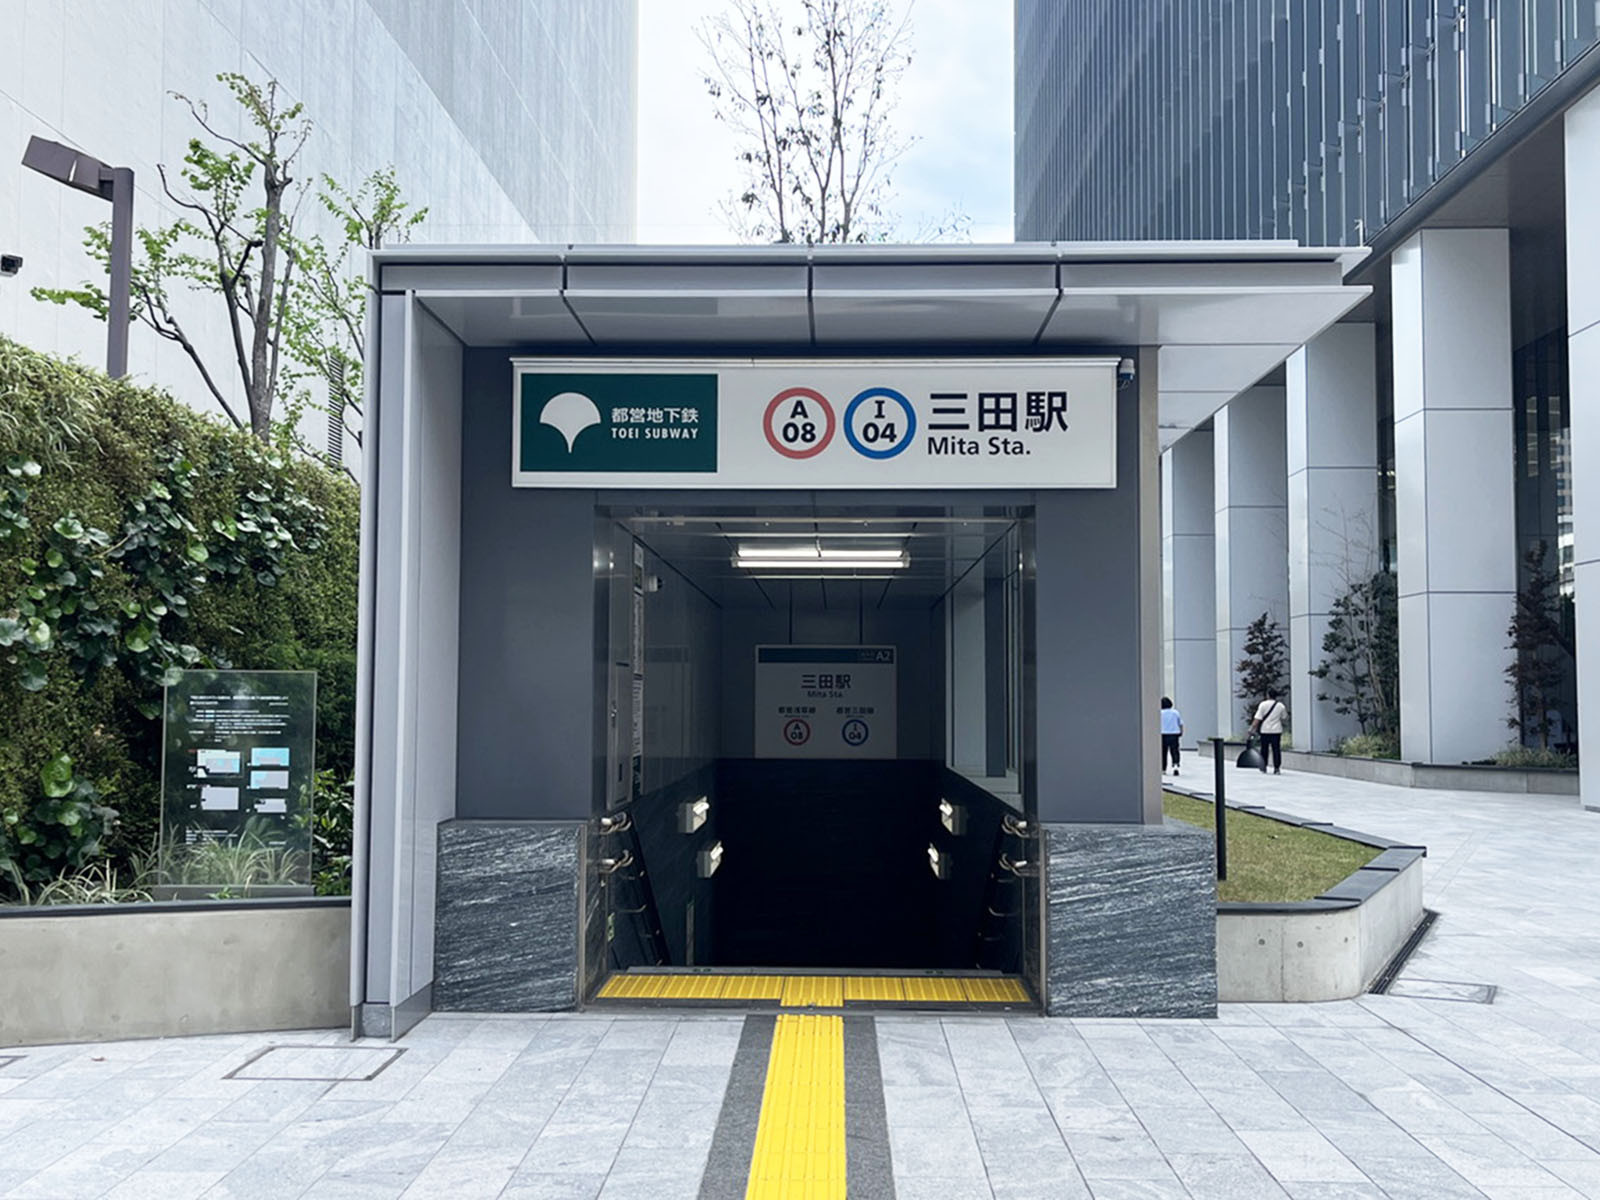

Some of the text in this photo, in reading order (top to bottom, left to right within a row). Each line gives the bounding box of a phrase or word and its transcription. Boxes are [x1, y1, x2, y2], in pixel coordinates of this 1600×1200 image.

[611, 407, 699, 424] 都営地下鉄
[790, 400, 809, 420] A
[874, 400, 886, 419] I
[928, 391, 1068, 432] 三田駅
[611, 427, 699, 439] TOEI SUBWAY
[782, 422, 816, 443] 08
[862, 422, 897, 443] 04
[928, 436, 1031, 455] Mita Sta.
[876, 651, 891, 661] A2
[801, 674, 851, 689] 三田駅
